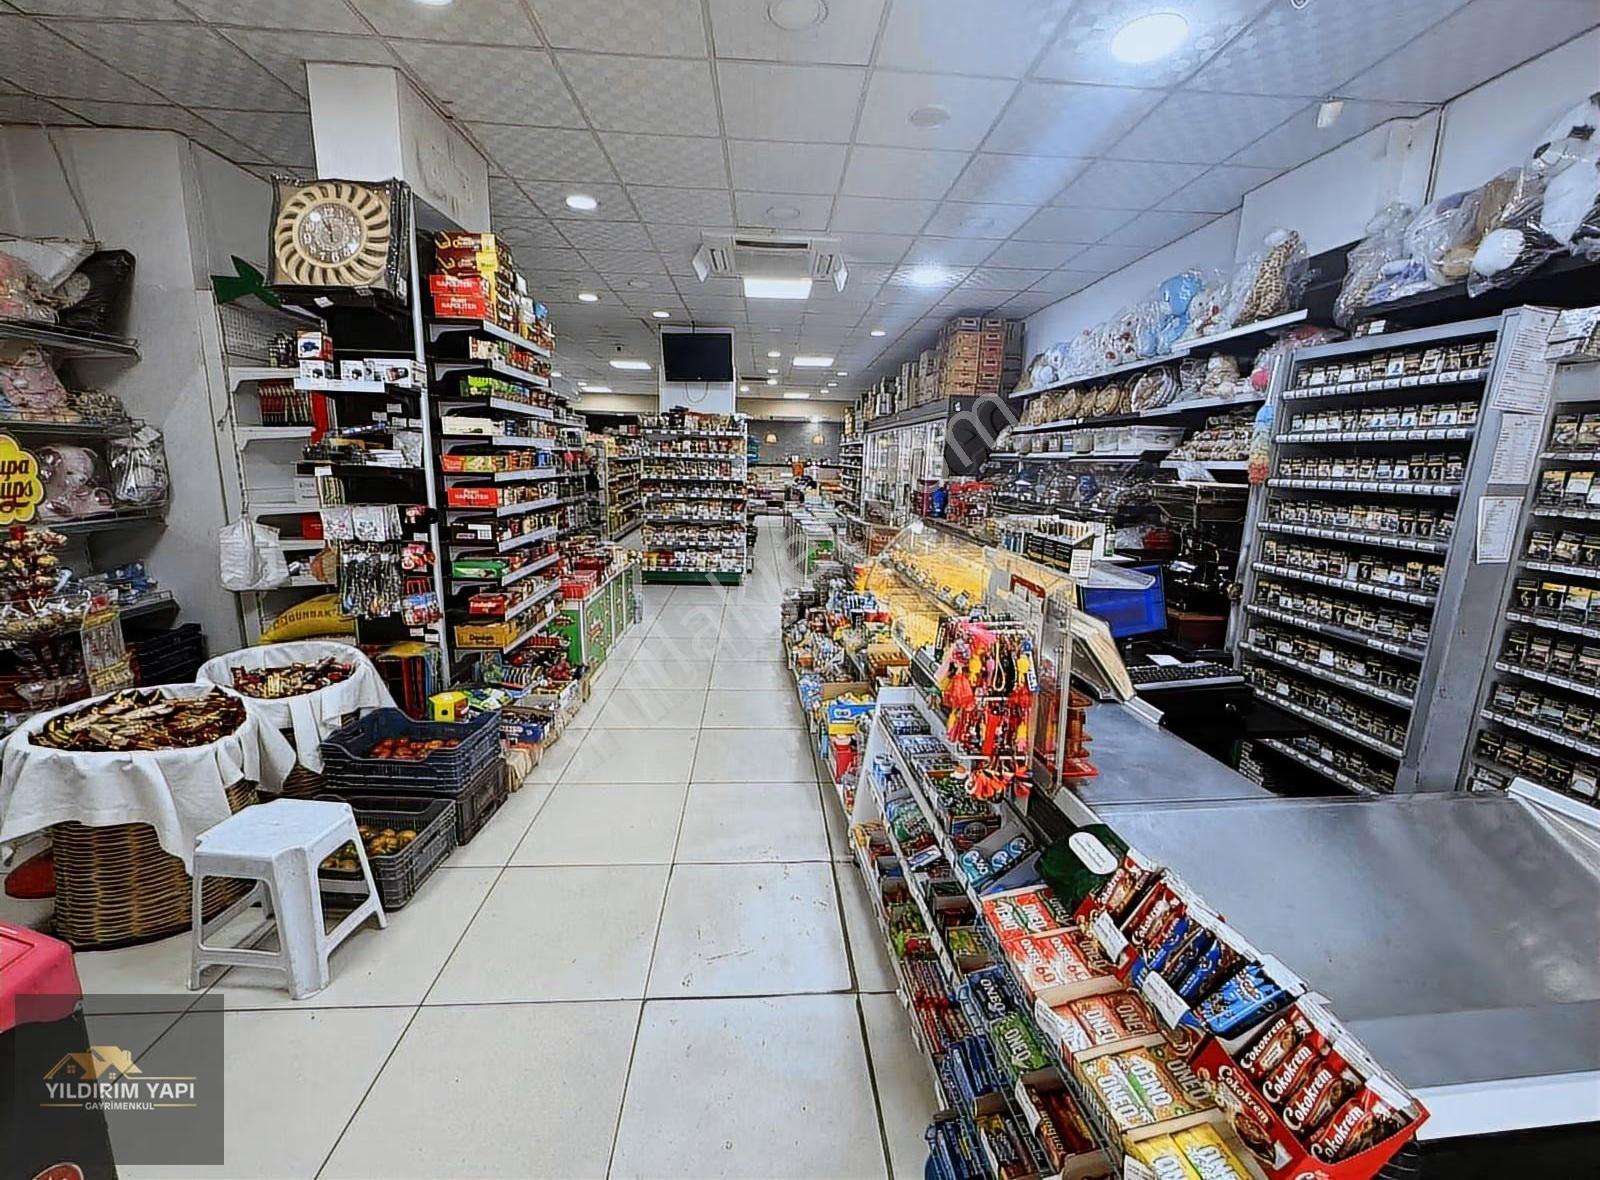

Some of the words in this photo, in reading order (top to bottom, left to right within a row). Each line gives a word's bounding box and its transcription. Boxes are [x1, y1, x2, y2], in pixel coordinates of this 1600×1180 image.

[1035, 965, 1056, 984] 60
[1004, 1028, 1032, 1062] ONEO
[1099, 1074, 1140, 1120] ONEO
[1167, 1058, 1211, 1101] ONEO
